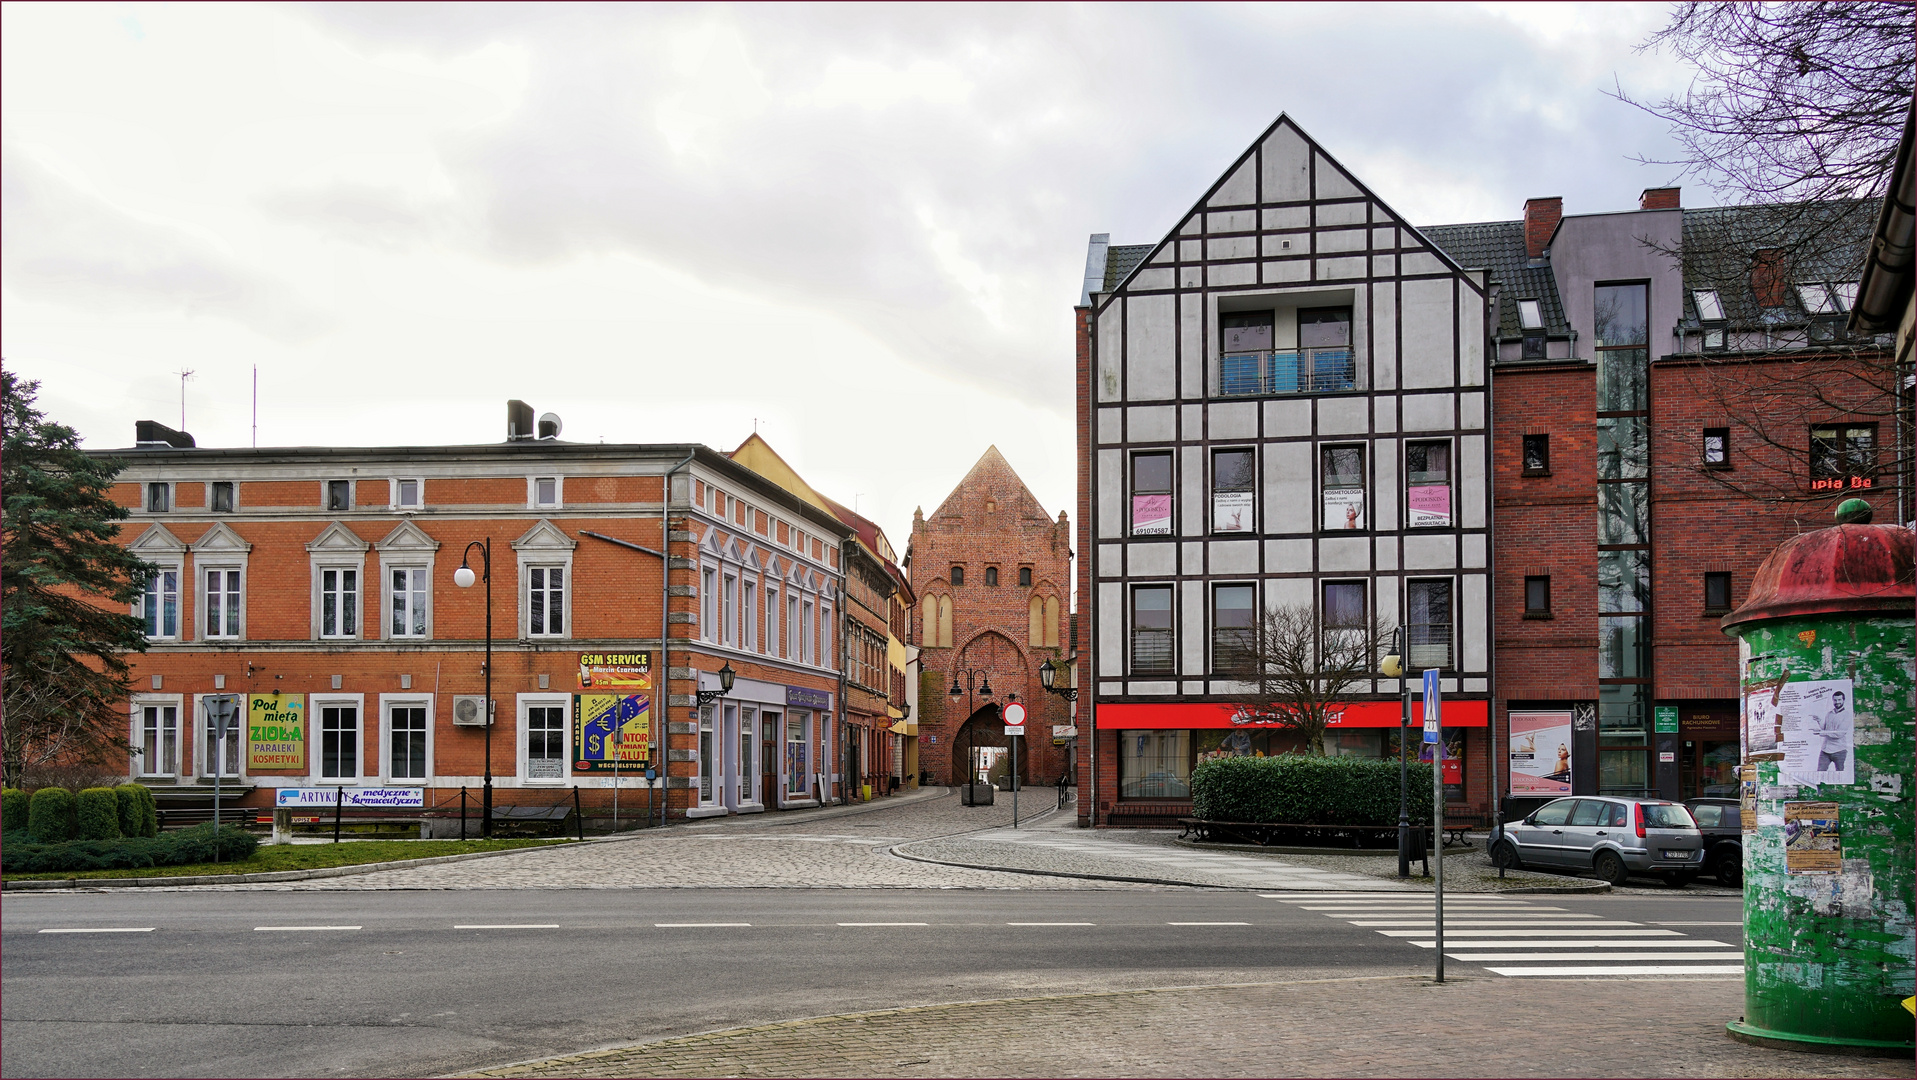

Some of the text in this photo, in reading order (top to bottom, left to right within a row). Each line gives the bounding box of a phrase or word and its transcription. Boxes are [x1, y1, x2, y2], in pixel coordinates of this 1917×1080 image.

[1136, 527, 1168, 535] 691074587
[581, 654, 647, 665] GSM SERVICE
[252, 699, 278, 711] Pod
[263, 711, 299, 724] miętą
[250, 726, 303, 742] ZIOŁA
[611, 733, 648, 743] NTOR
[254, 744, 296, 753] PARALEKI
[253, 755, 300, 764] KOSMETYKI
[301, 792, 352, 803] ARTYKUY:
[363, 789, 411, 797] medyczne
[351, 794, 422, 805] farmaceutyczne
